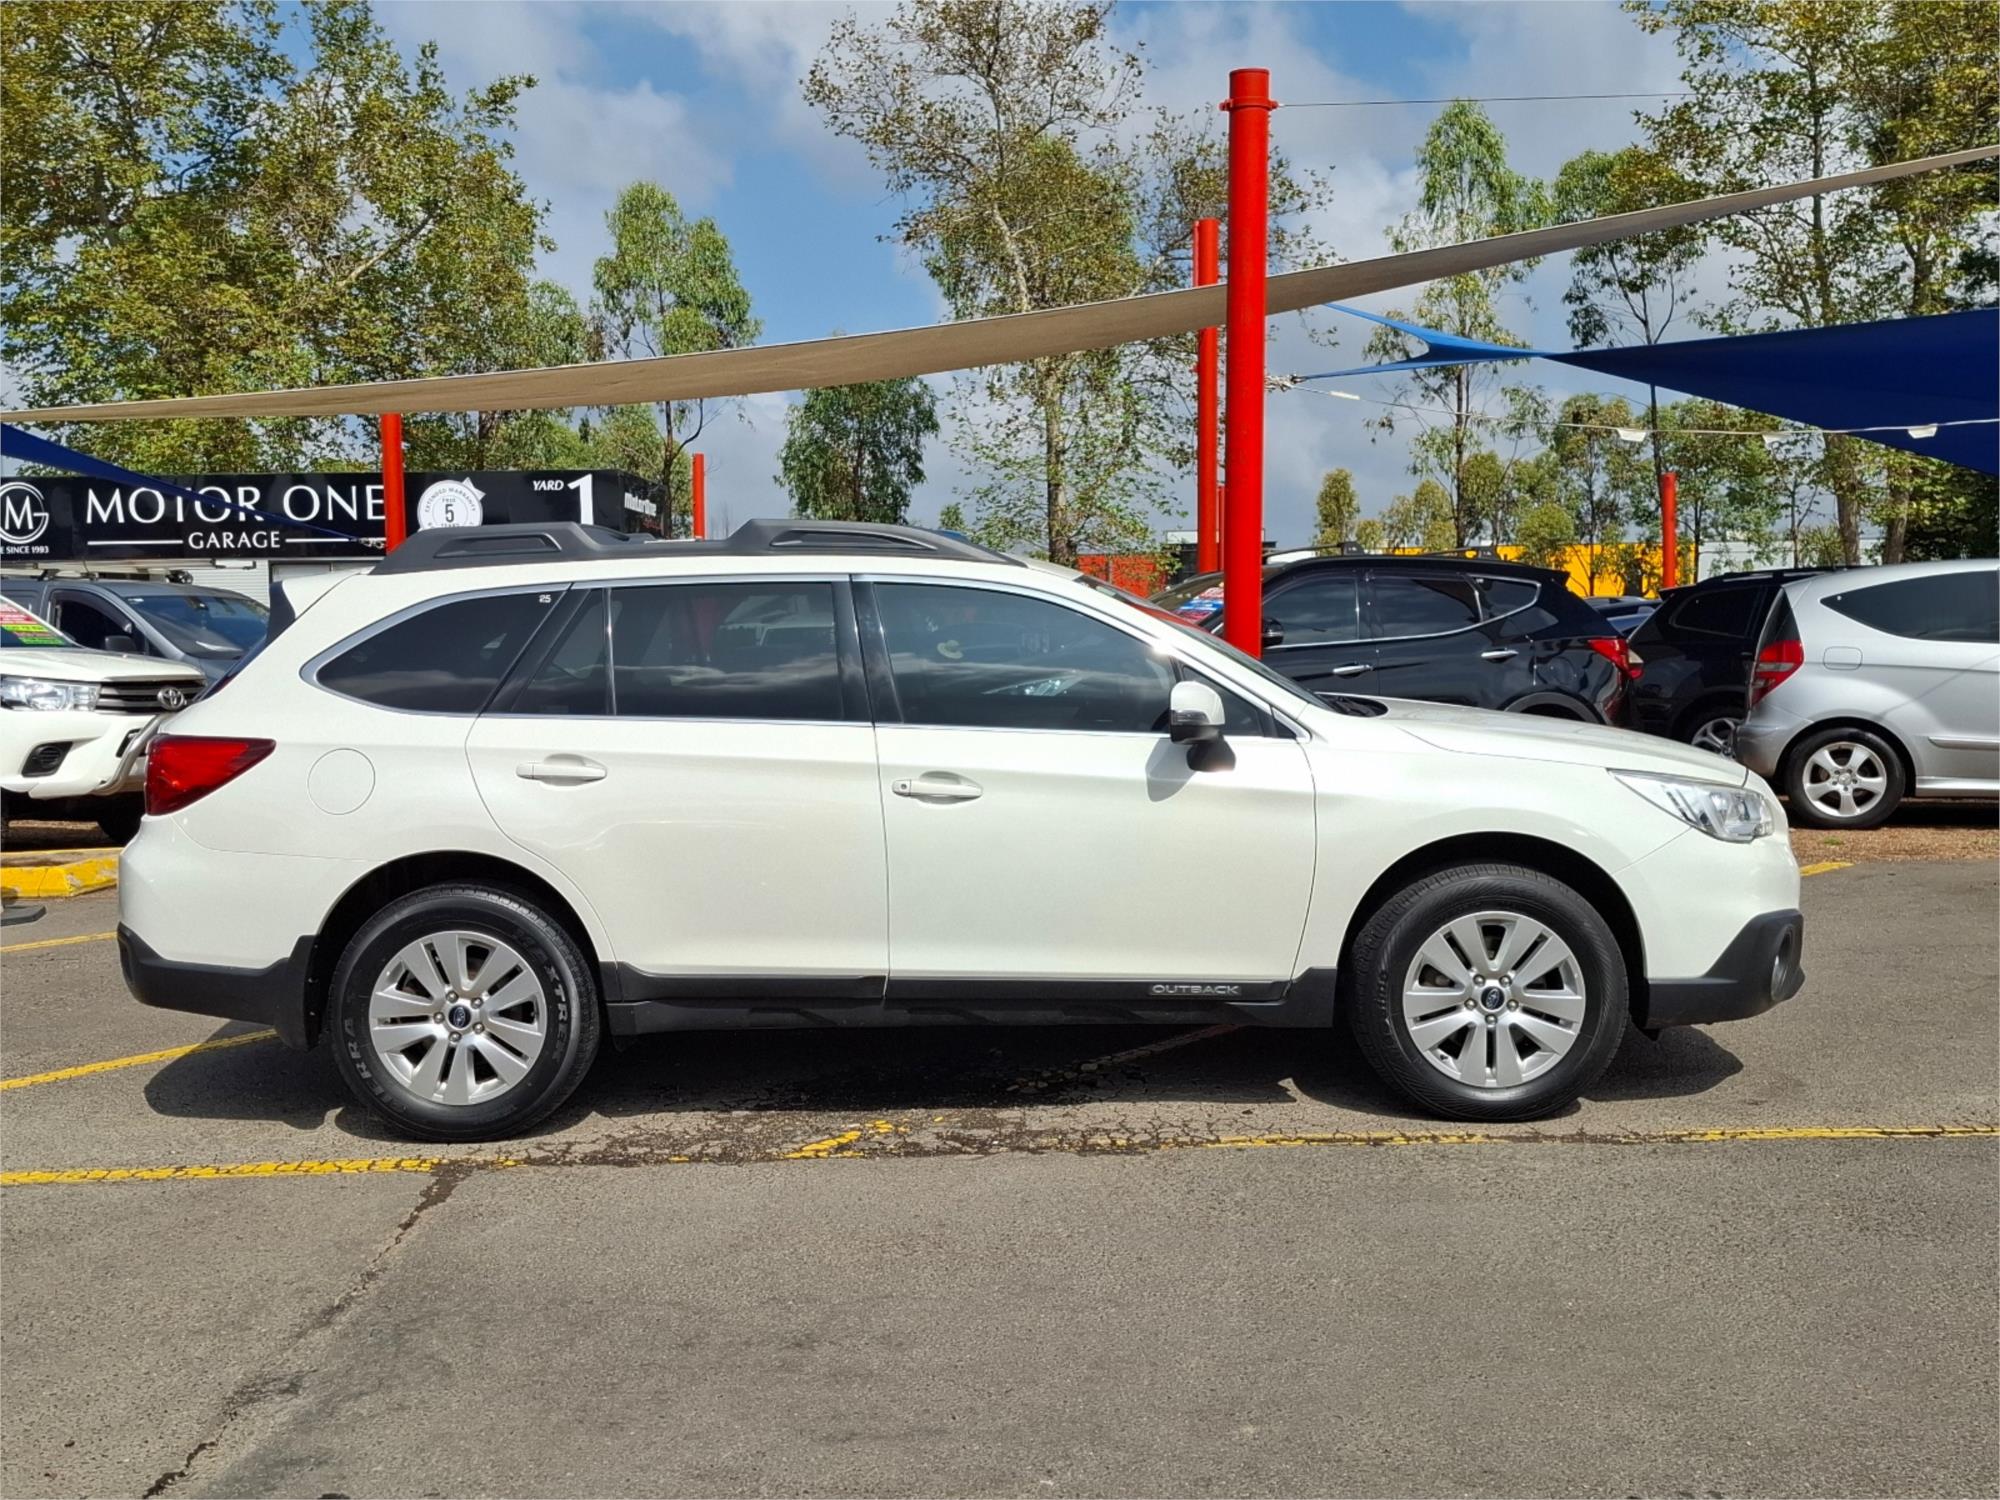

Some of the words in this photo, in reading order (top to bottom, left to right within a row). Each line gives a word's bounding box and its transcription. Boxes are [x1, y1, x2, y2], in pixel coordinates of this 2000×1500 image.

[85, 485, 264, 524] MOTOR
[282, 484, 386, 522] ONE
[532, 479, 565, 491] YARD
[566, 473, 594, 526] 1
[445, 503, 455, 523] 5
[6, 545, 30, 554] SINCE
[31, 545, 49, 554] 1993
[188, 531, 280, 549] GARAGE
[1152, 984, 1240, 994] OUTBACK
